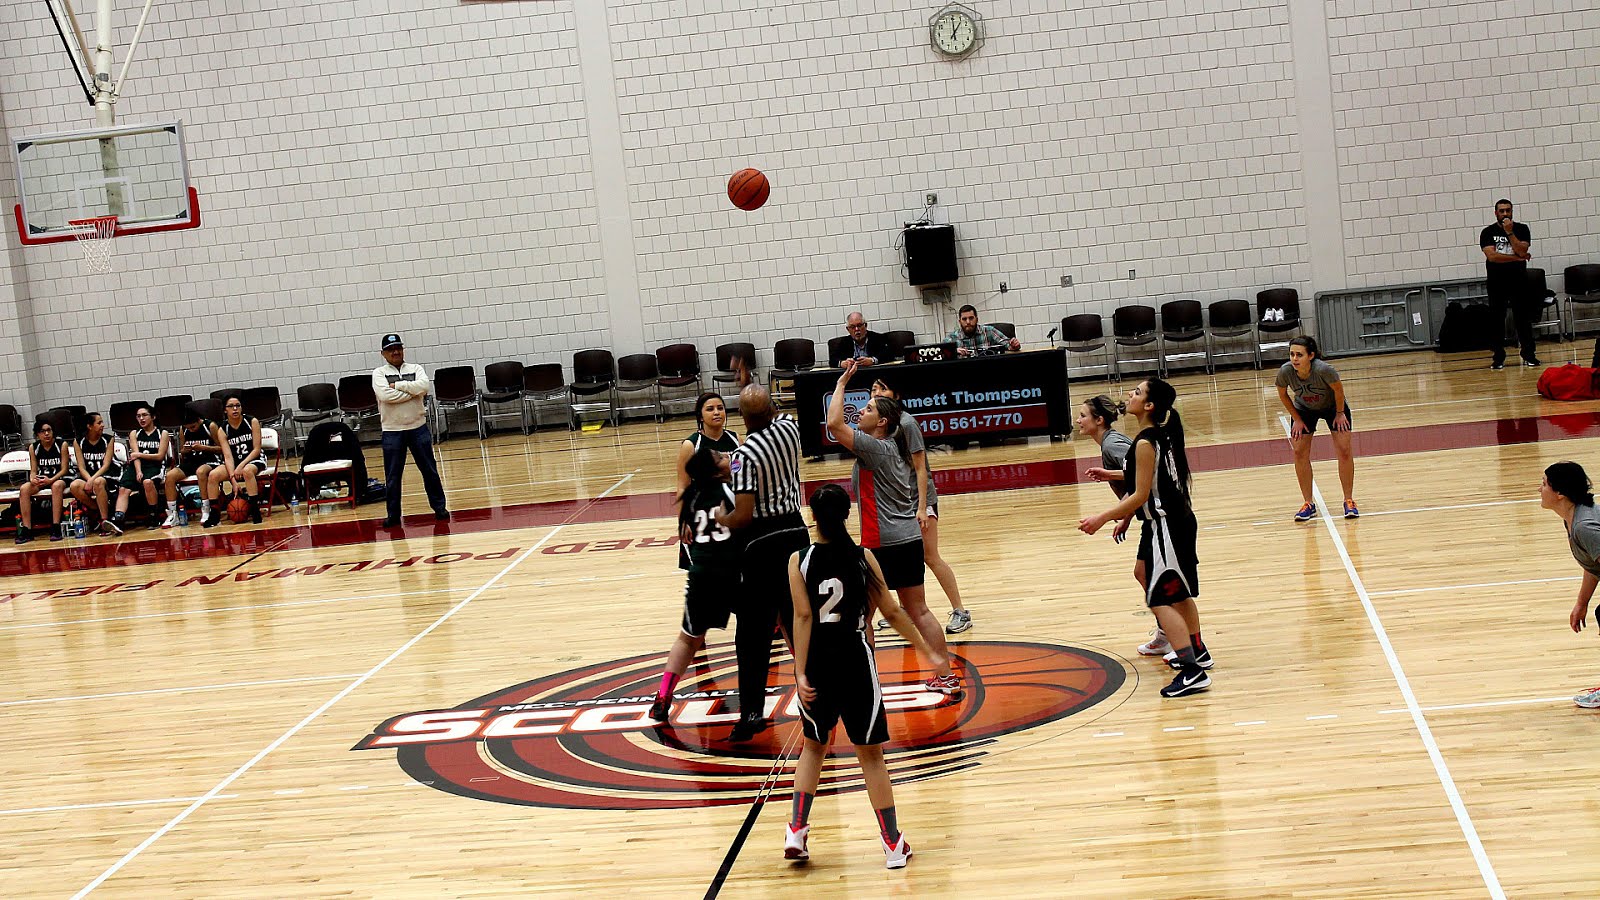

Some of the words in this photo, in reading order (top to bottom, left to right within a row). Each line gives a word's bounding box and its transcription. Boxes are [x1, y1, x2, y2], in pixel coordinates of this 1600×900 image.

[952, 387, 1042, 404] Thompson
[919, 419, 945, 434] 16)
[950, 412, 1023, 430] 561-7770
[694, 506, 731, 543] 23
[174, 547, 520, 588] POHLMAN
[819, 577, 844, 623] 2
[672, 686, 782, 700] VALLY
[366, 683, 950, 747] SCOUS
